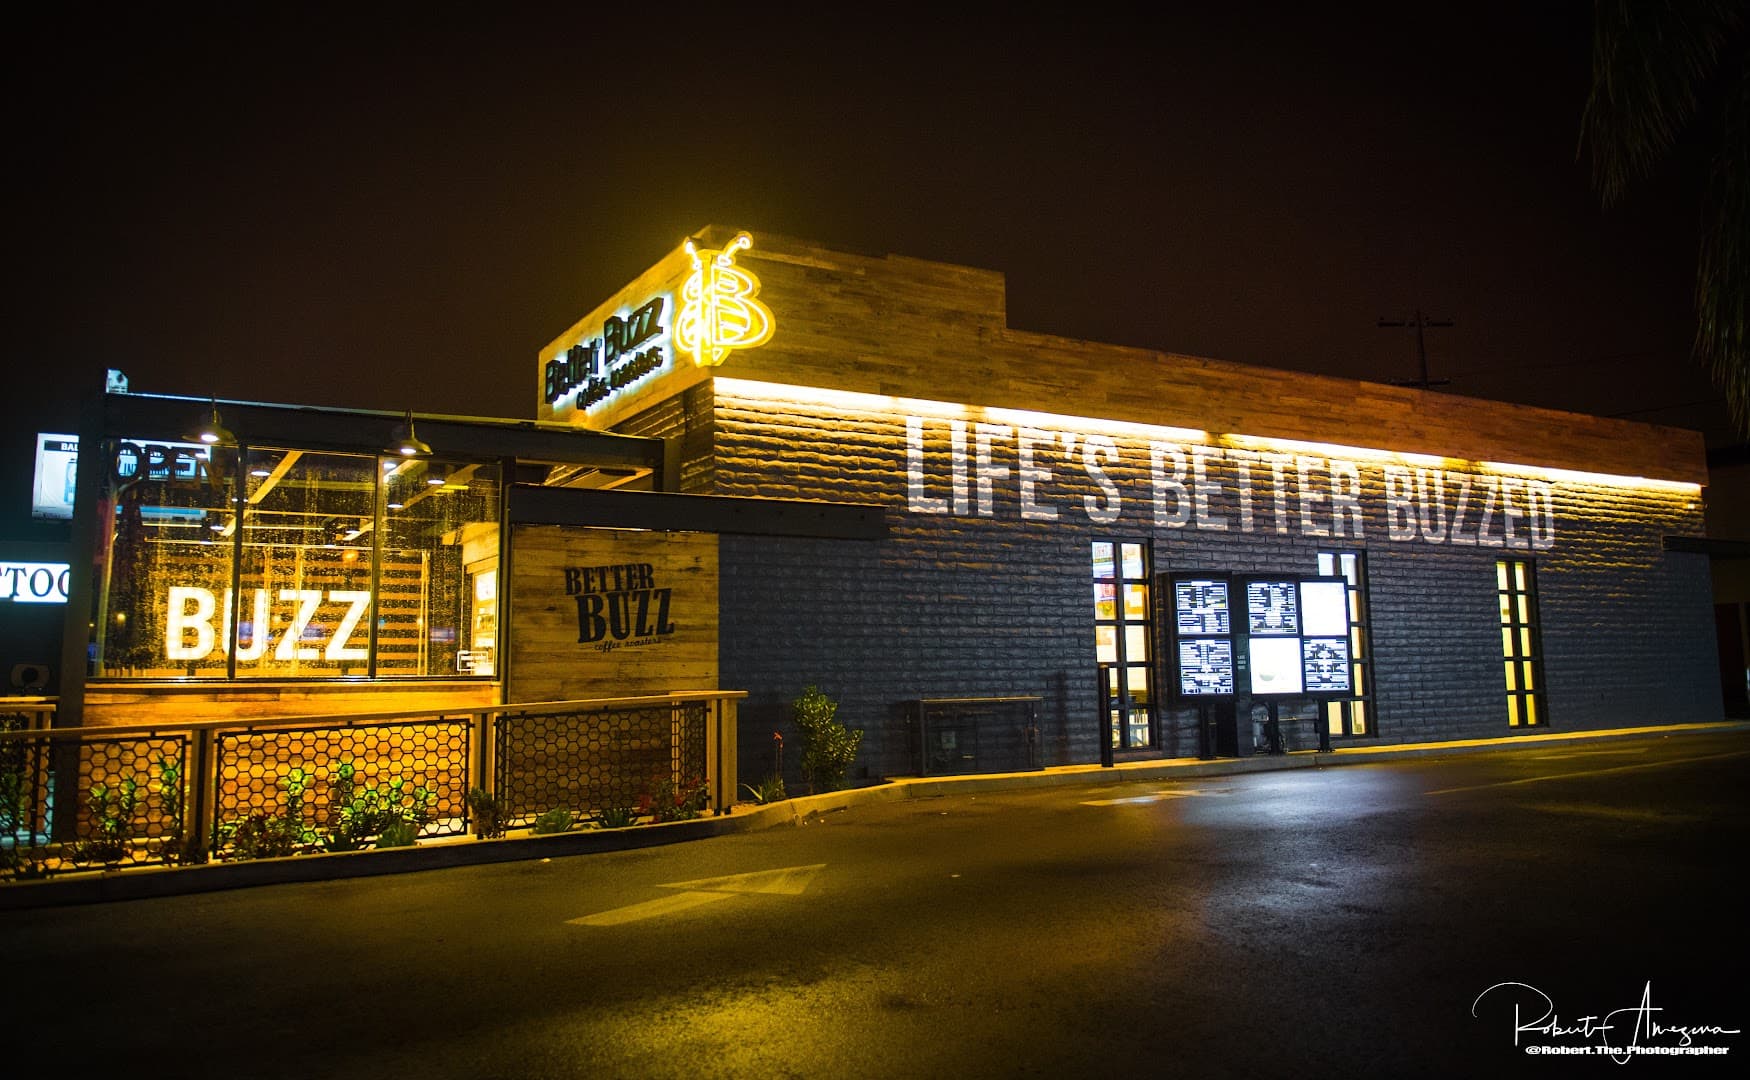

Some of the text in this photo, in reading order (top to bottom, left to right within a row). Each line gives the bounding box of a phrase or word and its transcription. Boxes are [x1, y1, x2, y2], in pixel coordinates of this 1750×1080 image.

[905, 414, 1556, 550] LIFE'S BETTER BUZZED
[564, 563, 656, 595] BETTER
[166, 586, 372, 661] BUZZ
[574, 588, 676, 644] BUZZ
